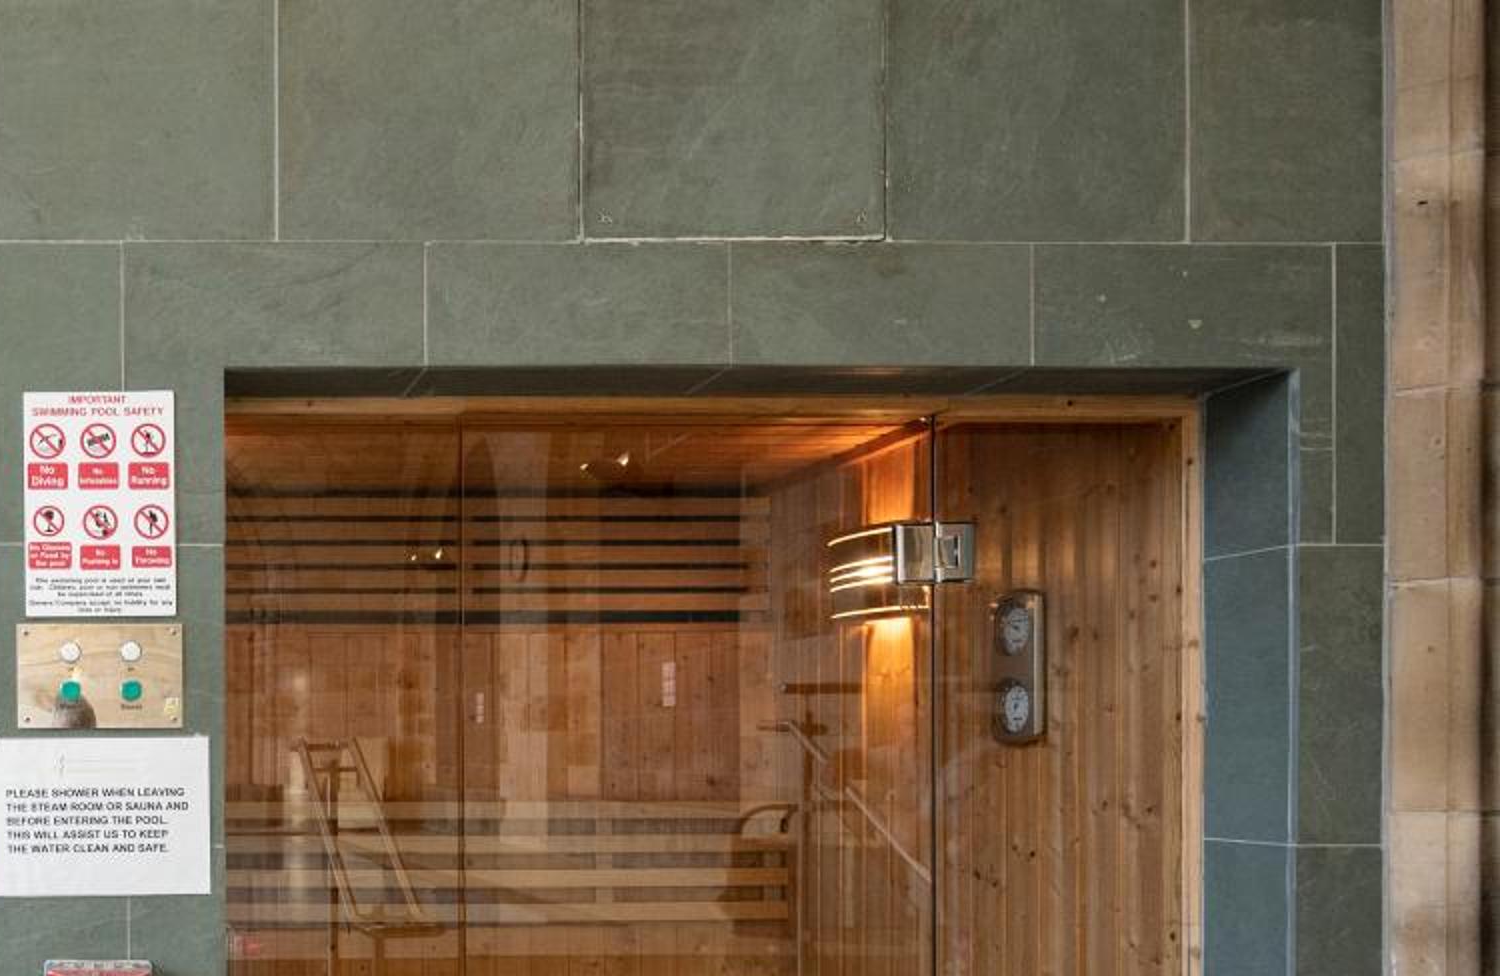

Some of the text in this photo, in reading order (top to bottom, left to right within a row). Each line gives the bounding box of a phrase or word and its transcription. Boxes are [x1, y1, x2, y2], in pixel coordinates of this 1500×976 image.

[68, 395, 126, 404] IMPORTANT
[32, 407, 164, 416] SWIMMING POOL SAFETY
[39, 466, 54, 475] No
[142, 466, 155, 475] No
[31, 476, 64, 488] Diving
[131, 476, 167, 487] Running
[6, 787, 185, 798] PLEASE SHOWER WHEN LEAVING
[7, 801, 189, 812] THE STEAM ROOM OR SAUNA AND
[7, 817, 50, 826] BEFORE
[53, 816, 108, 826] ENTERING
[112, 815, 133, 824] THE
[7, 829, 169, 840] THIS WILL ASSIST US TO KEEP
[8, 844, 29, 854] THE
[31, 844, 70, 853] WATER
[73, 843, 109, 853] CLEAN
[112, 843, 135, 853] AND
